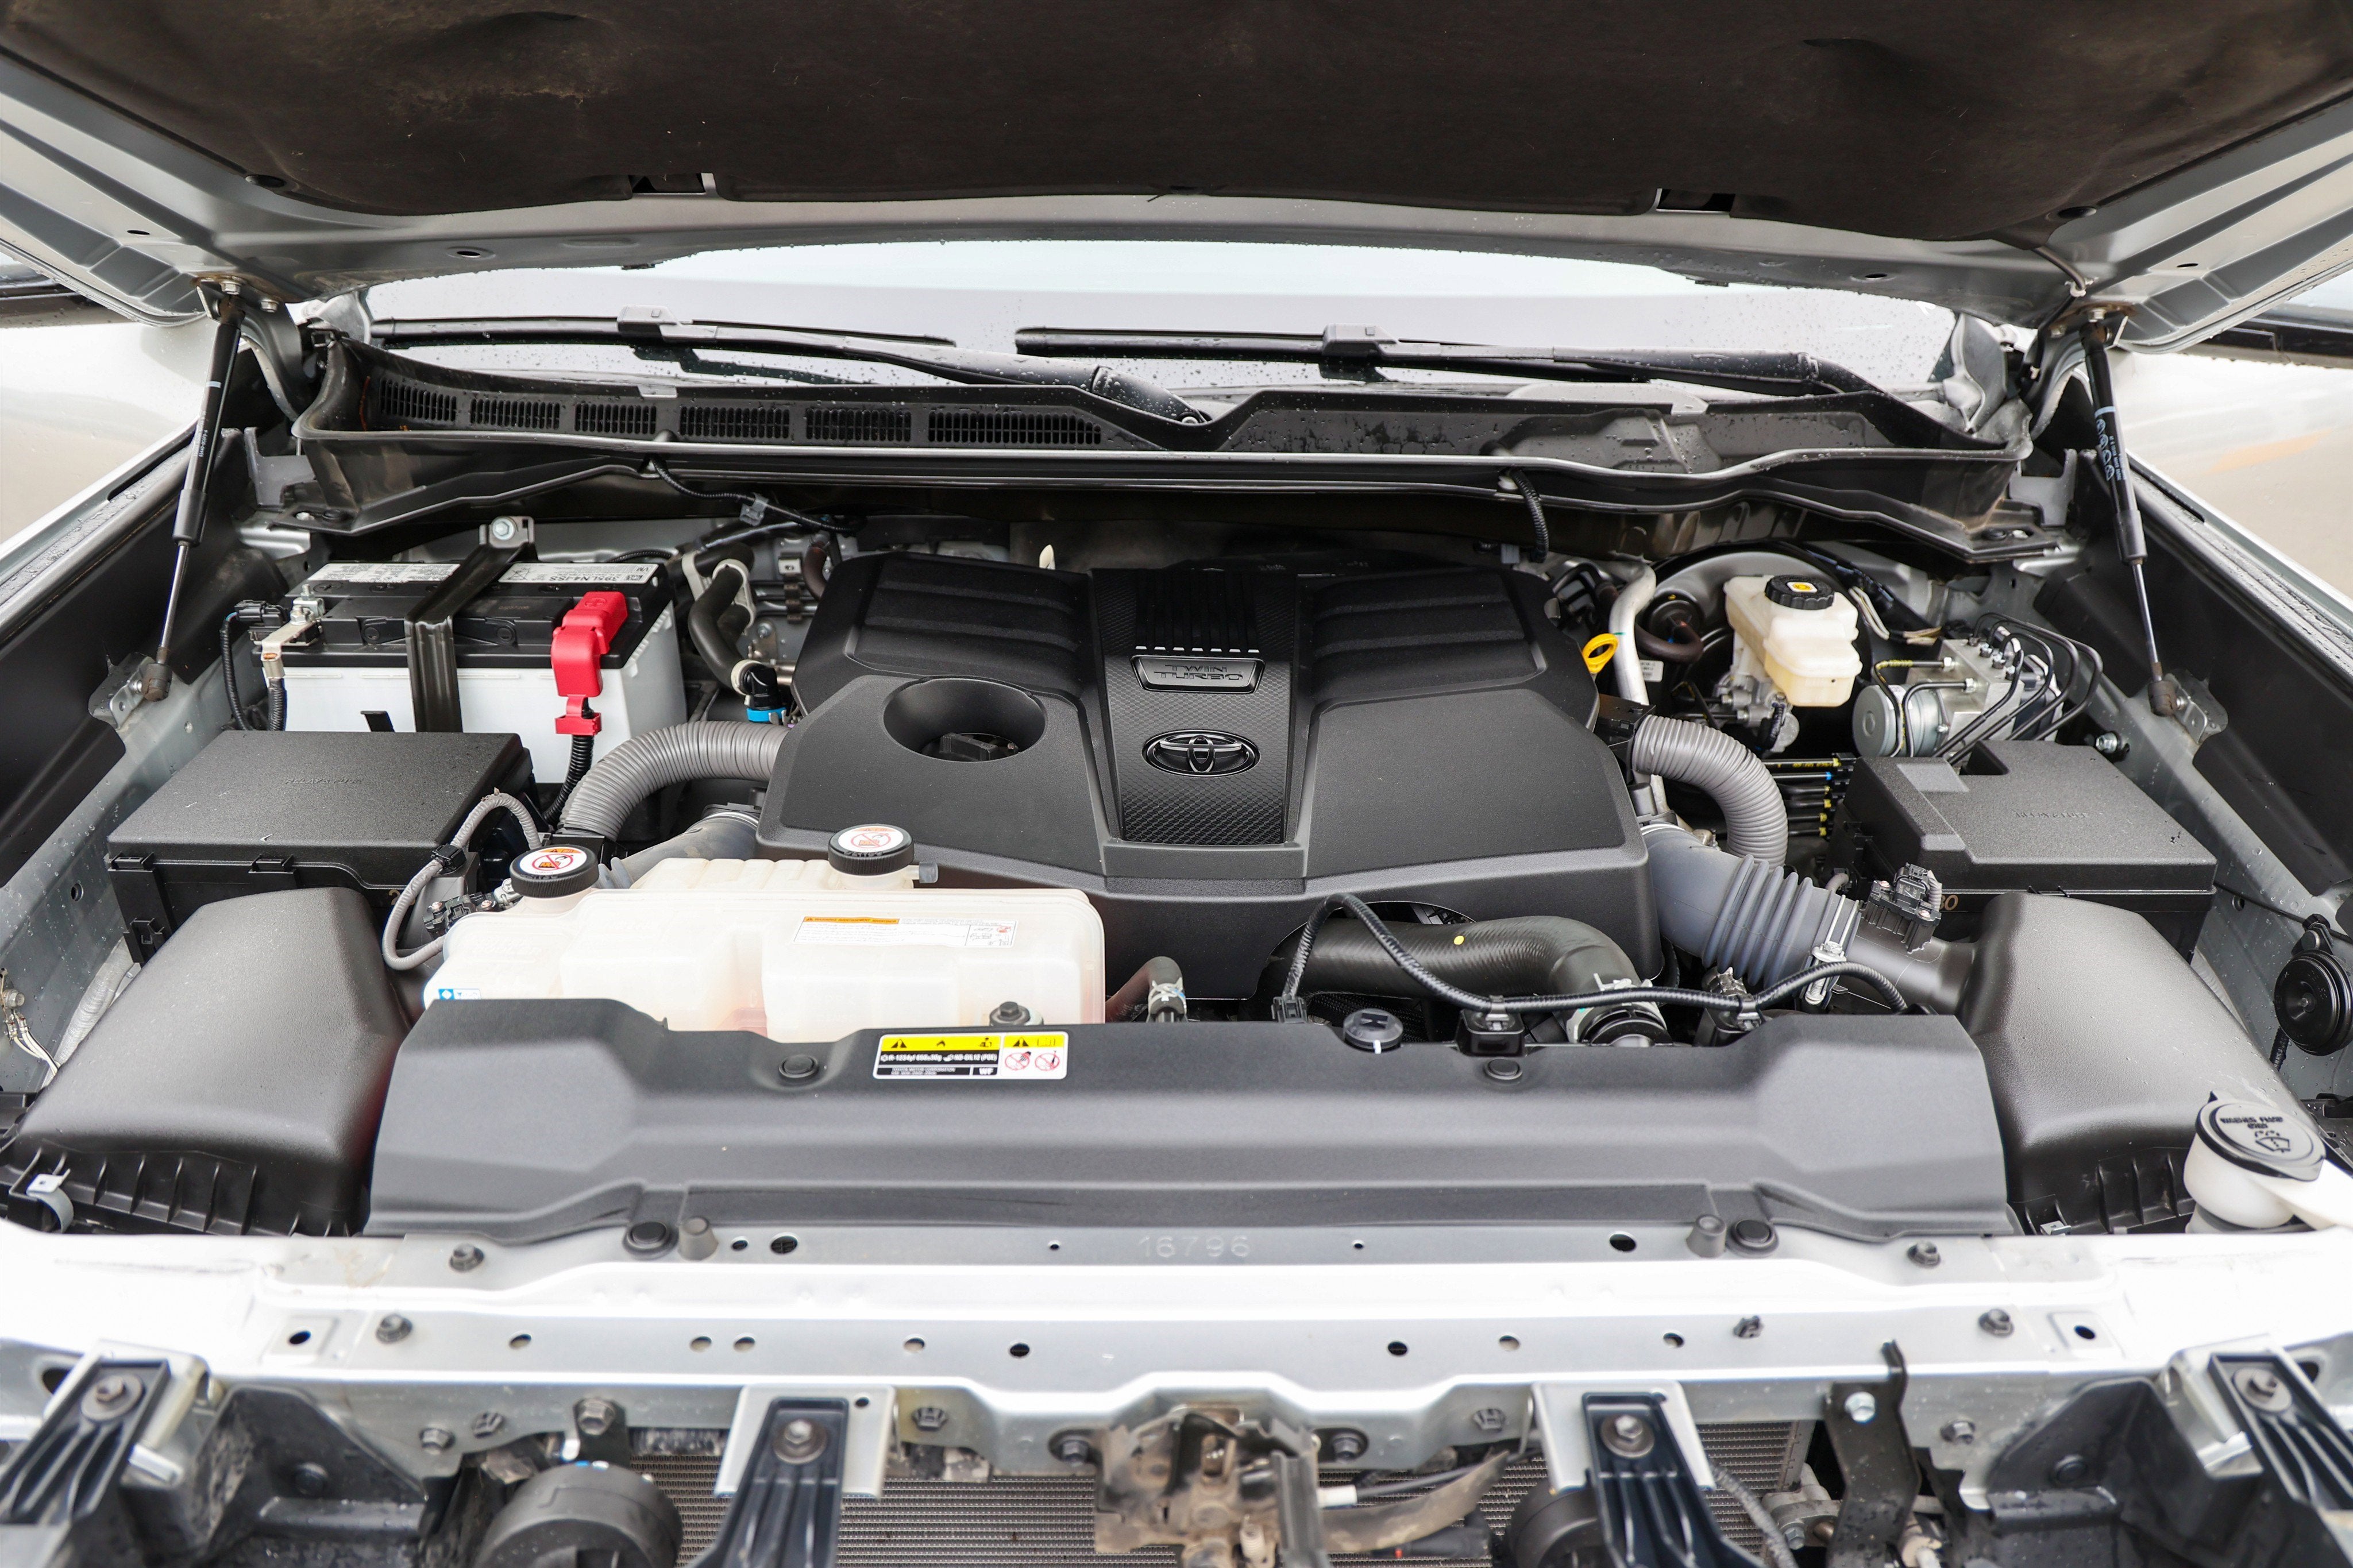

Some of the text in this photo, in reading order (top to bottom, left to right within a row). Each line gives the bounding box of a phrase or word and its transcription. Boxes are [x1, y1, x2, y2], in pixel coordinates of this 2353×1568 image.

[1165, 665, 1227, 673] TWIN
[1154, 671, 1243, 681] TURBO
[1138, 1235, 1251, 1258] 16796
